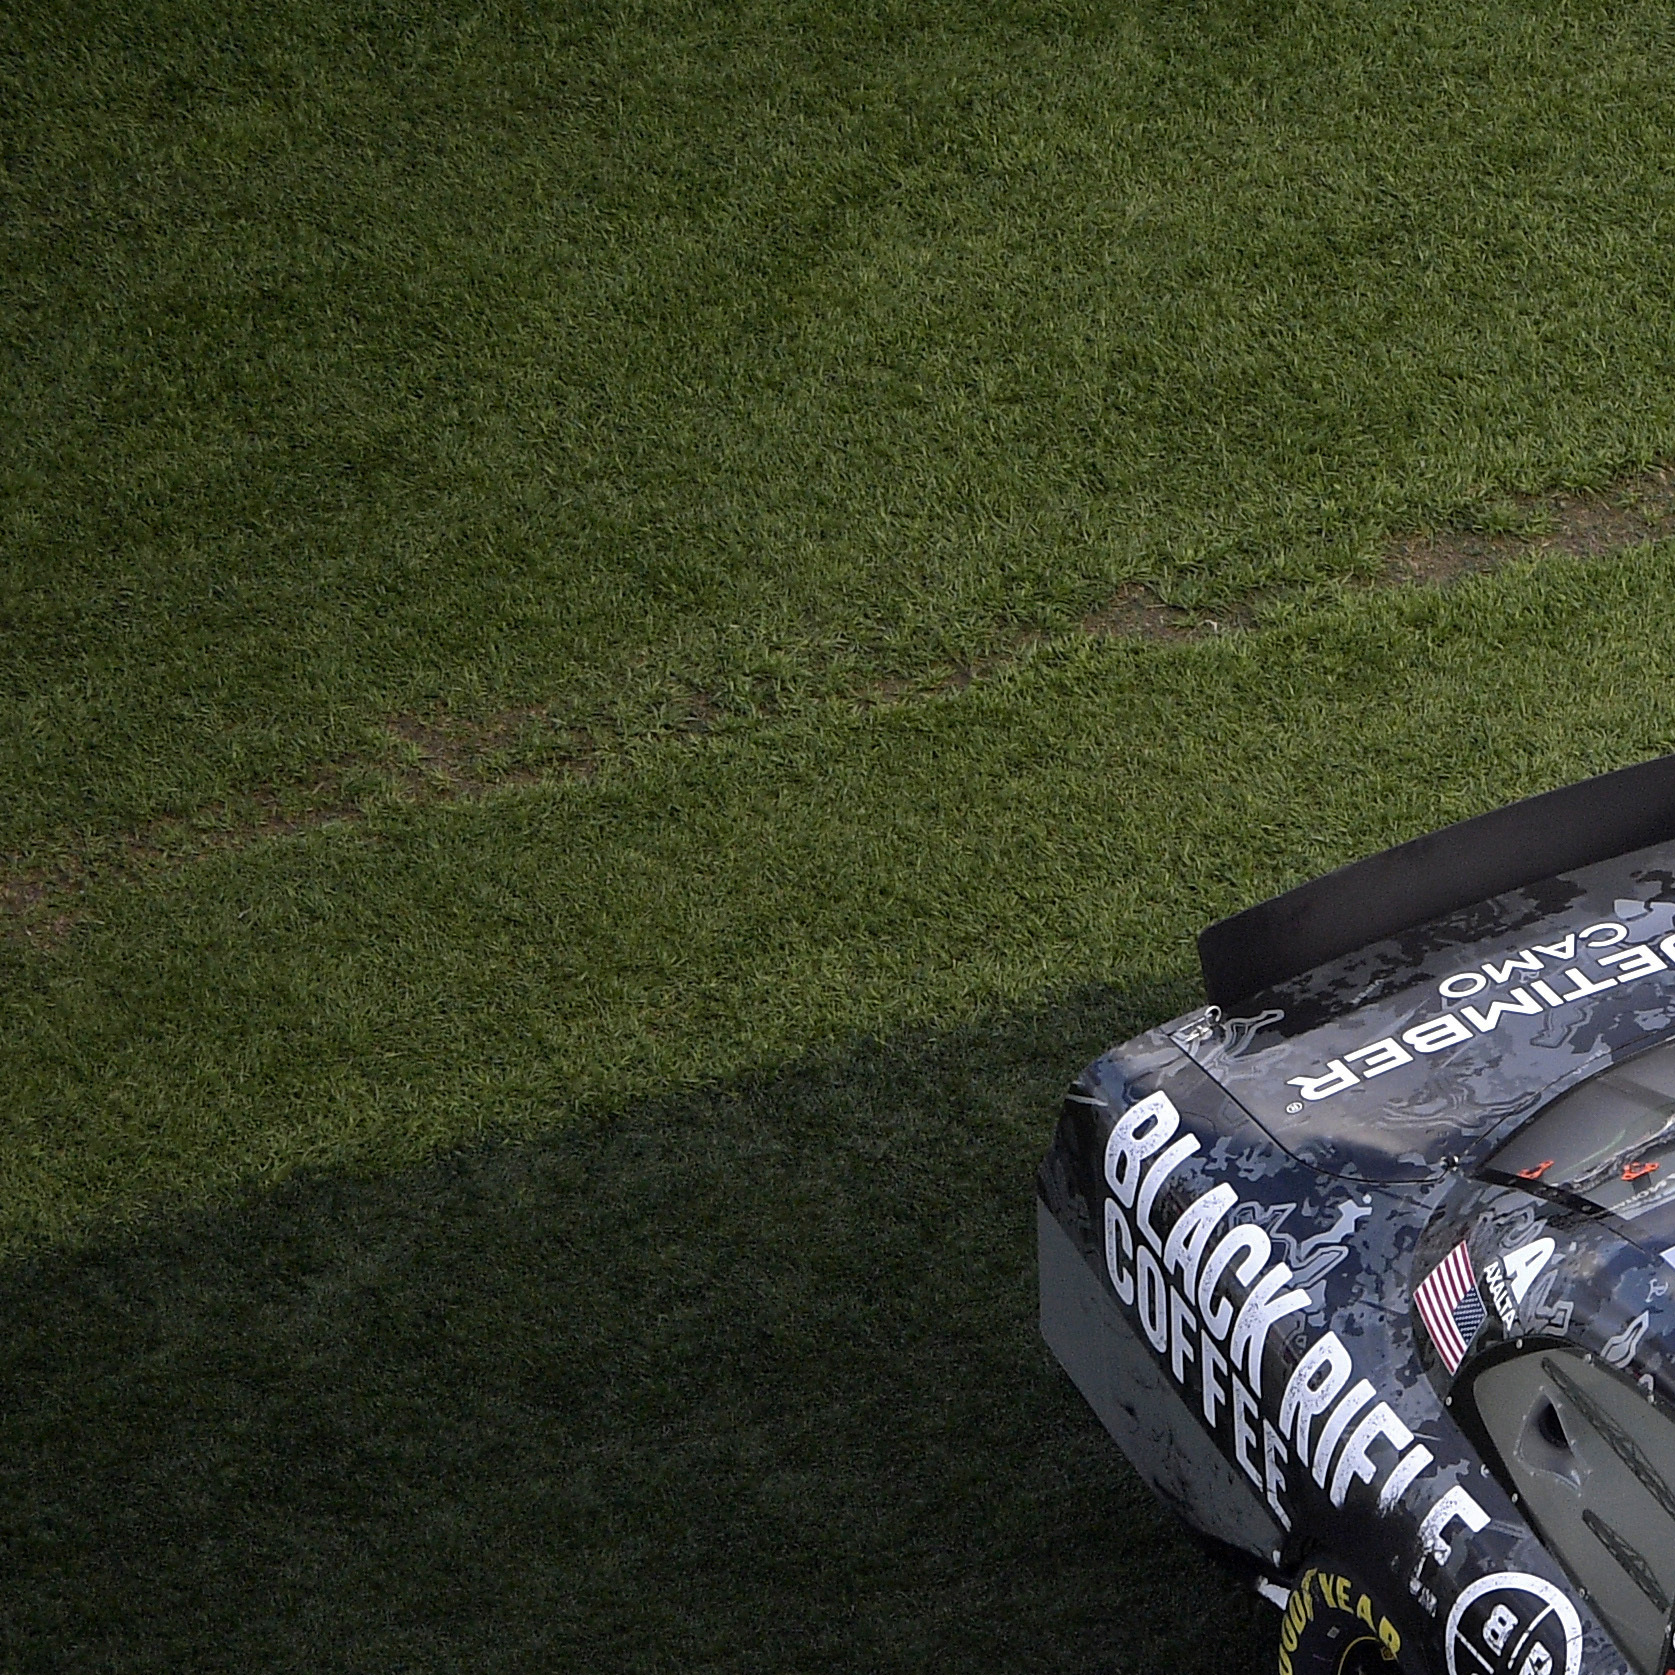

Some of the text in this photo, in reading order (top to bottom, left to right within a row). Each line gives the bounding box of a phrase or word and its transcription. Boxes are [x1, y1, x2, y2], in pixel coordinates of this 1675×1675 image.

[1437, 920, 1632, 1001] CAMO
[1103, 1088, 1313, 1398] BLACK
[1482, 1260, 1518, 1331] AXALTA
[1103, 1196, 1292, 1533] COFFEE
